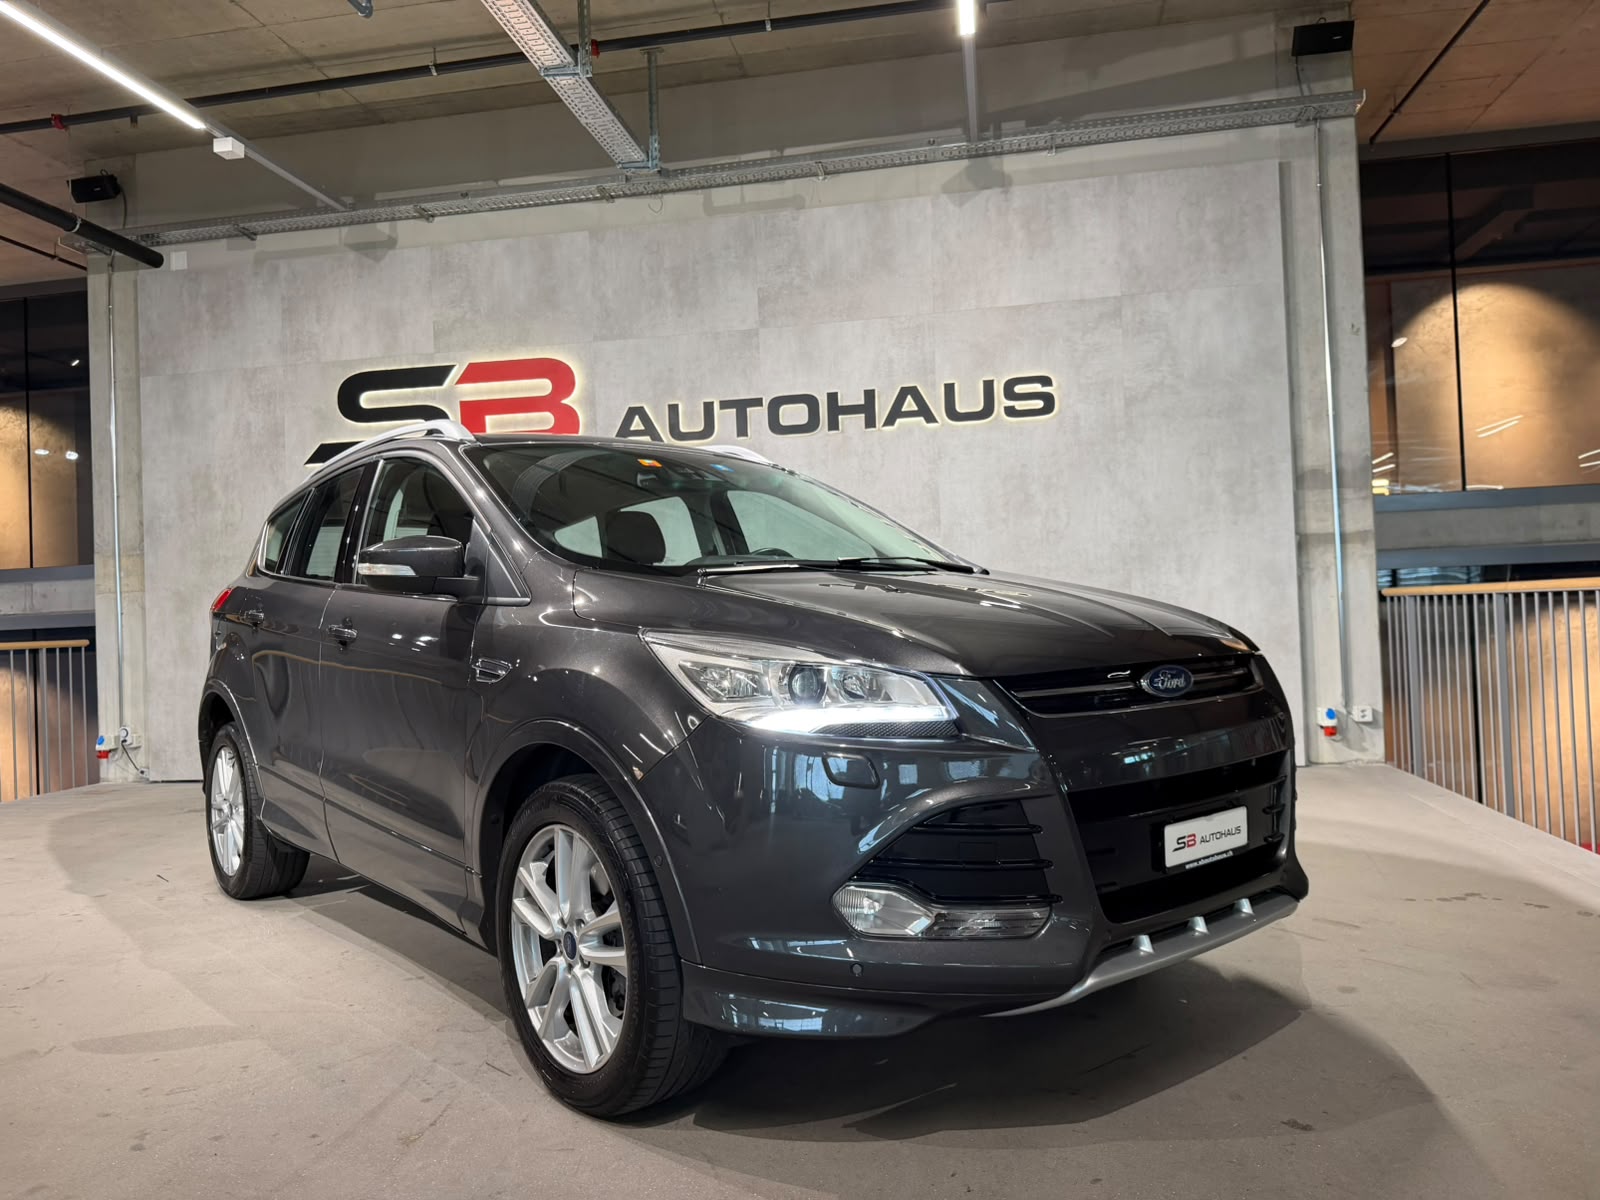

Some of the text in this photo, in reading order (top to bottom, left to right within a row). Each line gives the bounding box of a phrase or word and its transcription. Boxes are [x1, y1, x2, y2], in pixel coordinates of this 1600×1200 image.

[304, 357, 1056, 465] SB AUTOHAUS
[1153, 669, 1187, 690] Ford
[1172, 825, 1242, 852] SB AUTOHAUS
